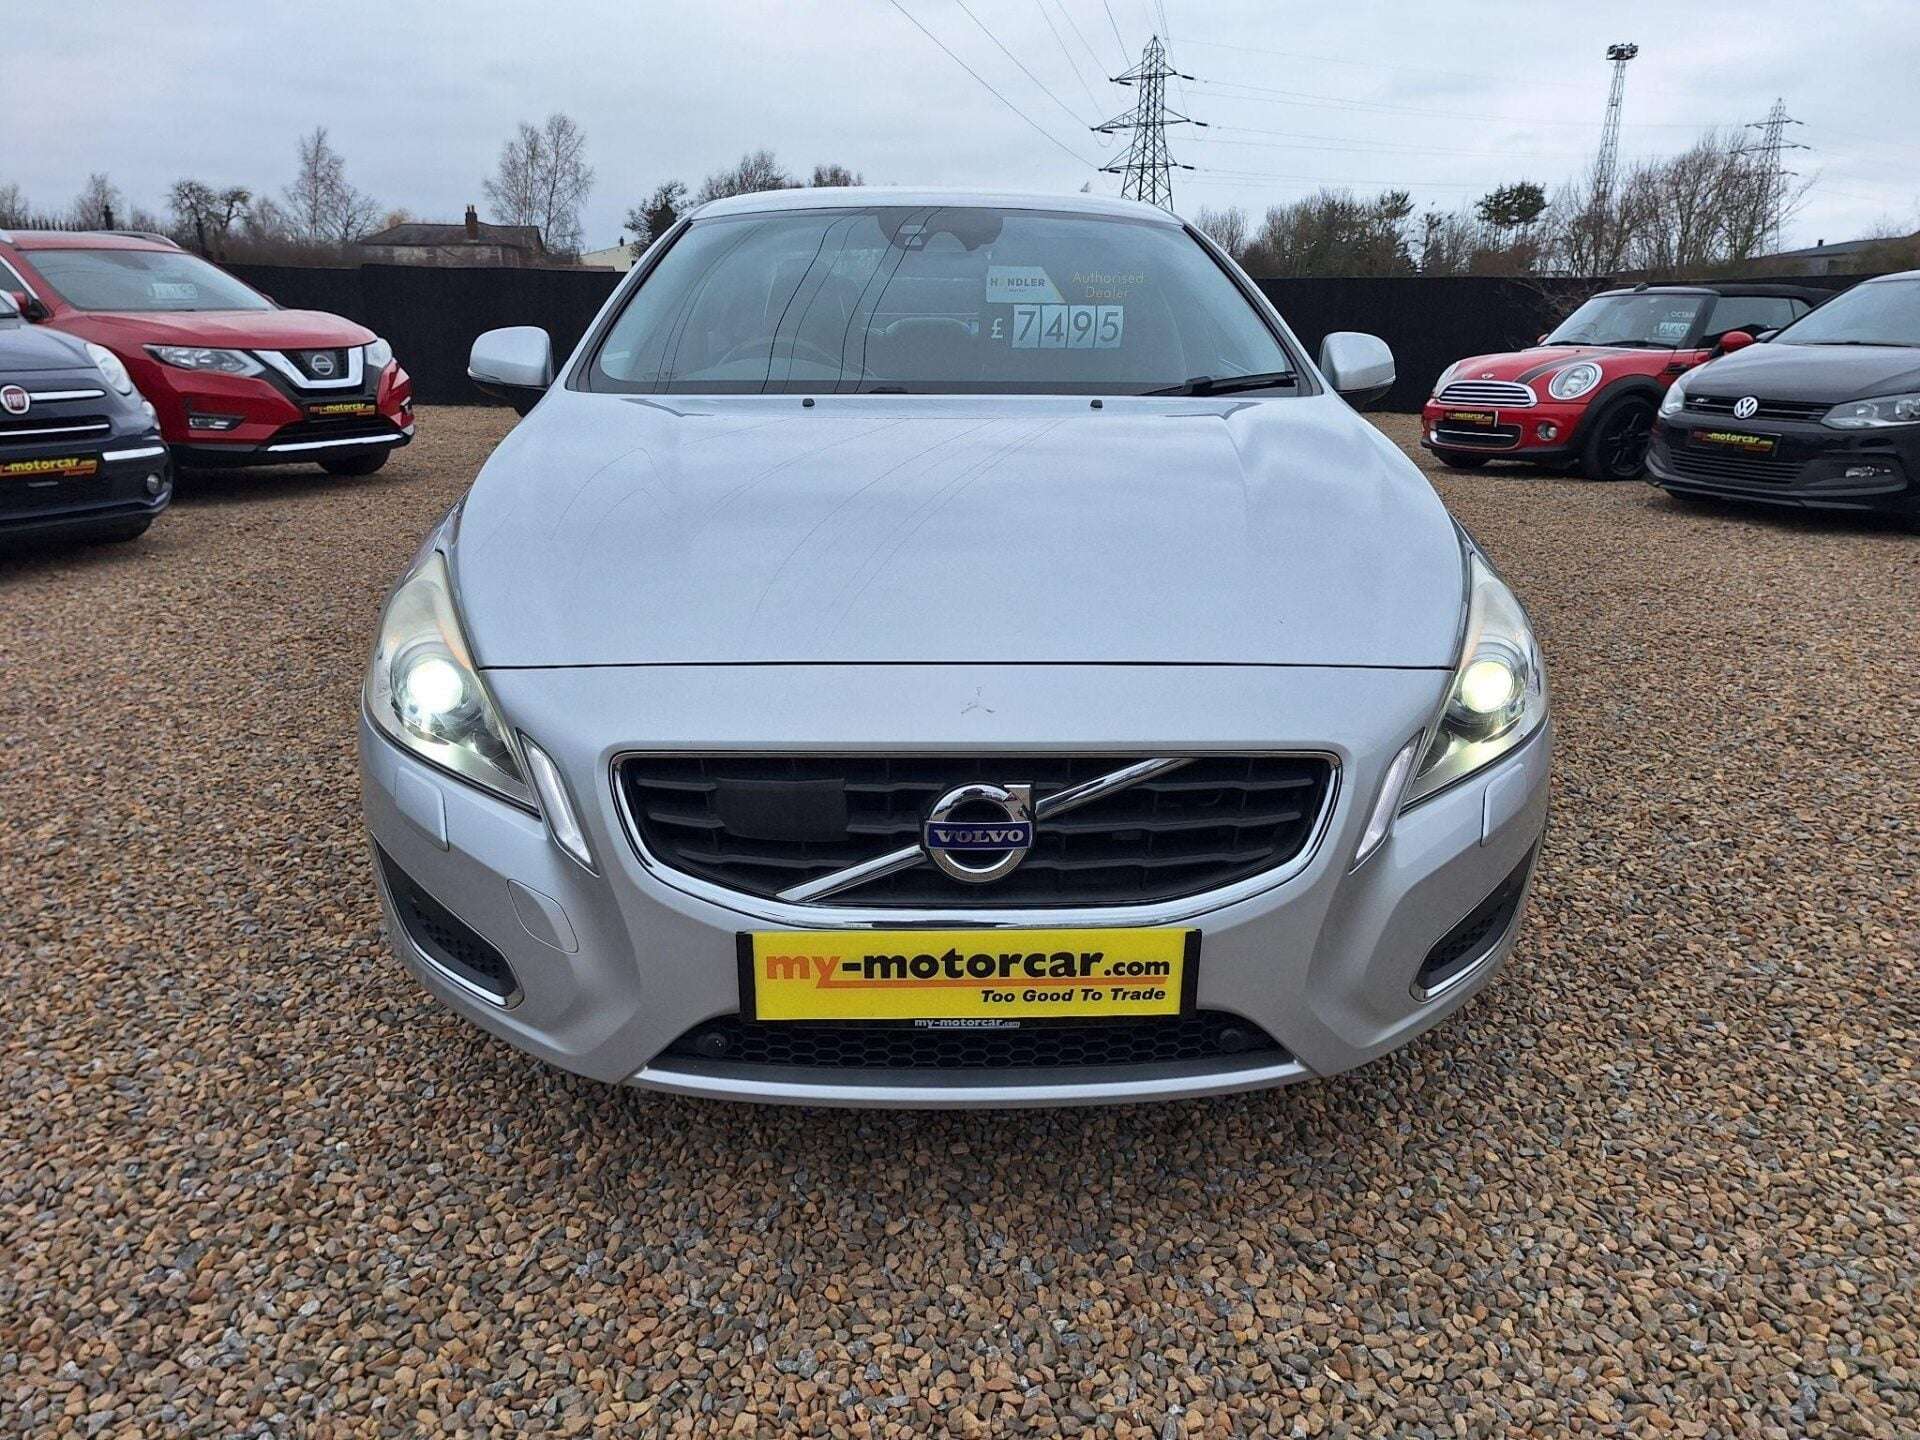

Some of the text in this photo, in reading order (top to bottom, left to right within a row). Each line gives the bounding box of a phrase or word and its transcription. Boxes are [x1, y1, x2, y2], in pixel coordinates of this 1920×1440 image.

[990, 277, 1047, 287] HNDLER
[1072, 271, 1145, 285] Authorised
[1086, 287, 1129, 299] Dealer
[309, 403, 376, 415] my-motorcar.
[1694, 431, 1774, 446] -motorcar.
[933, 829, 1024, 843] VOLVO
[765, 947, 1171, 987] my-motorcar.com
[980, 987, 1166, 1003] Too Good To Trade
[914, 1019, 1020, 1029] my-motorcar.com
